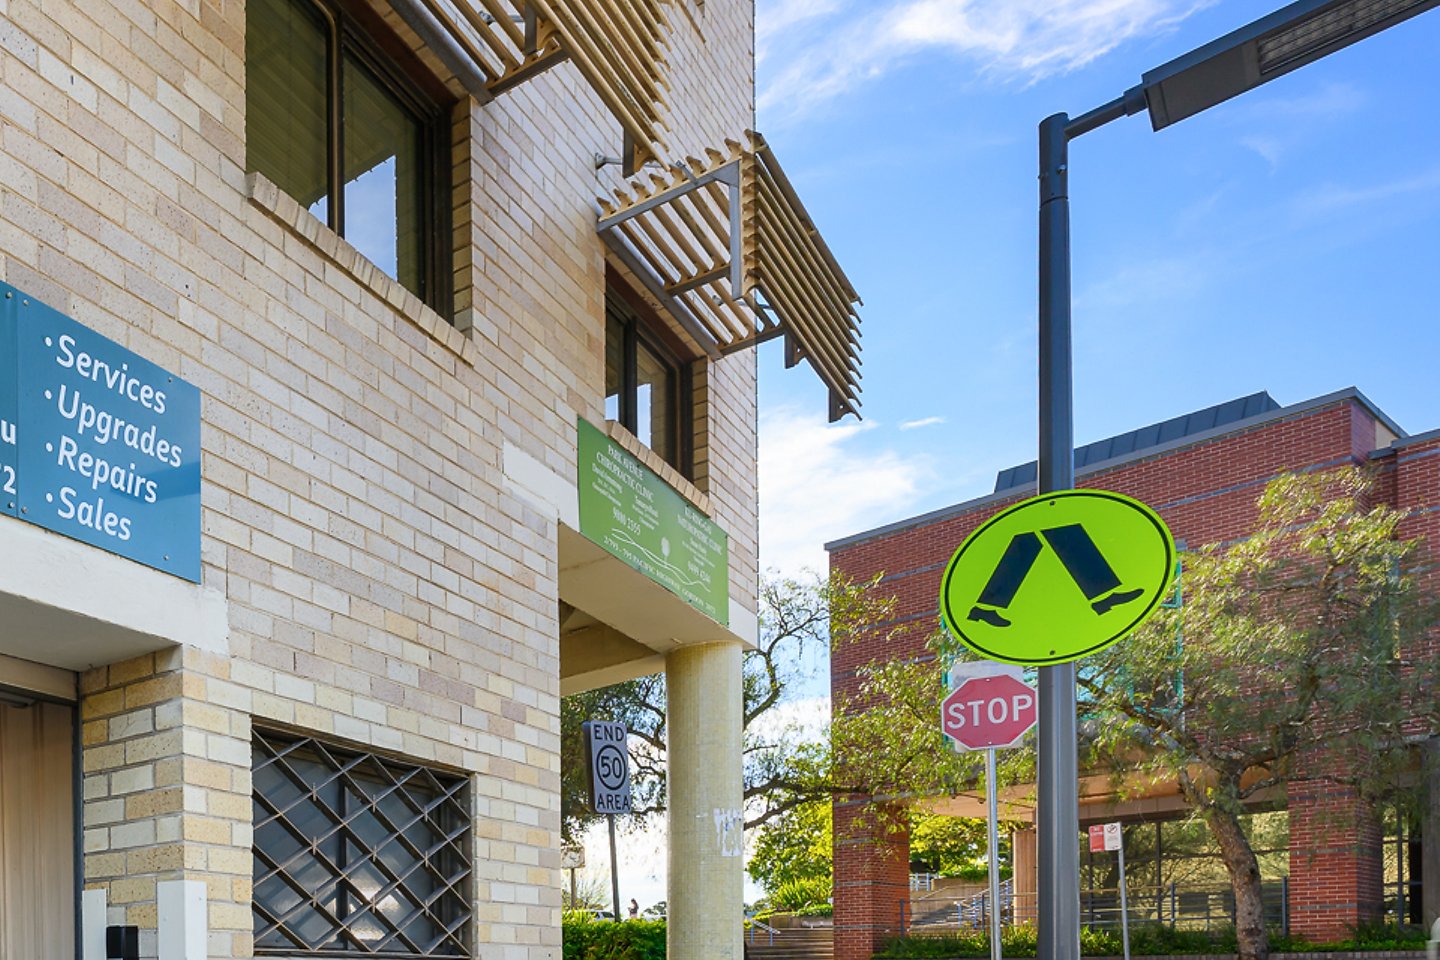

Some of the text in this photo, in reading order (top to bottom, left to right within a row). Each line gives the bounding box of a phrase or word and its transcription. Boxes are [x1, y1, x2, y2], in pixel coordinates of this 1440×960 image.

[55, 334, 167, 415] Services
[57, 384, 183, 468] Upgrades
[56, 435, 158, 504] Repairs
[57, 486, 132, 541] Sales
[593, 724, 625, 742] END
[947, 693, 1033, 730] STOP
[600, 755, 623, 779] 50
[596, 793, 631, 811] AREA
